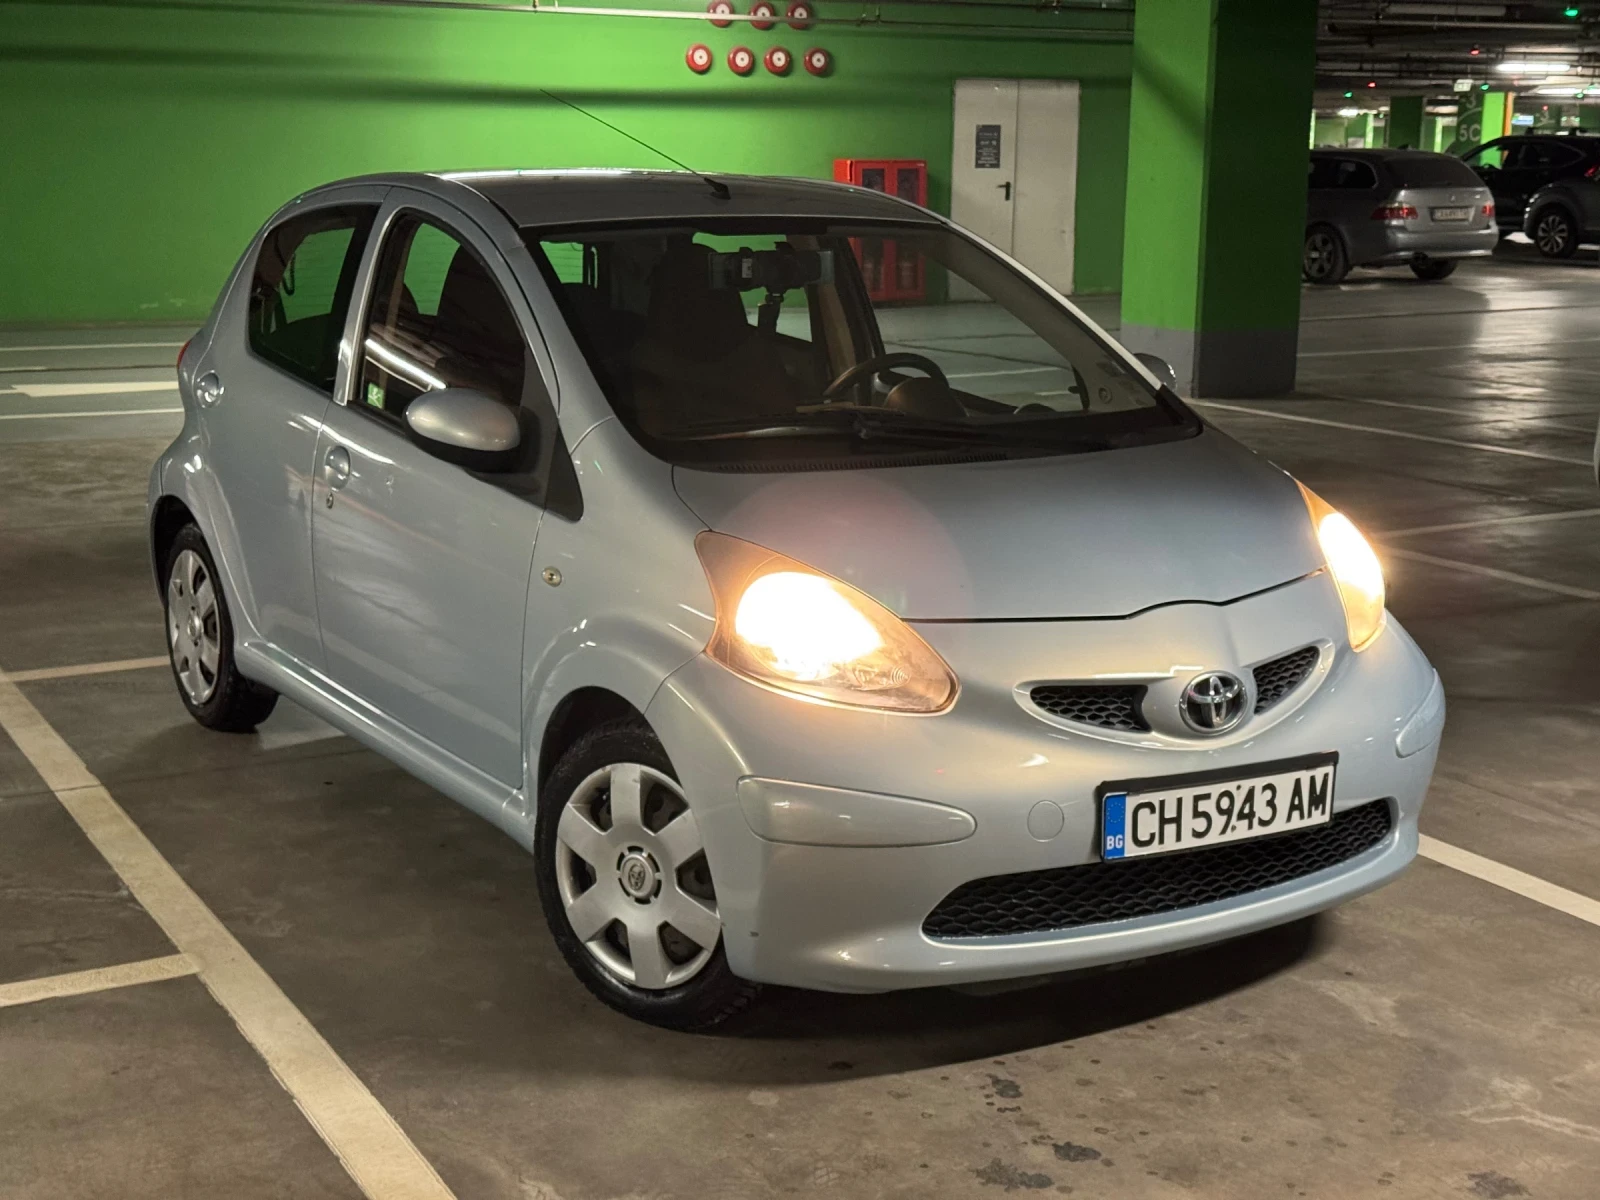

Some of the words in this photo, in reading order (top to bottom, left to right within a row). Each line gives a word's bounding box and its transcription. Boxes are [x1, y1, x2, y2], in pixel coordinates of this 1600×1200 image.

[1132, 797, 1183, 848] CH
[1192, 783, 1278, 839] 5943
[1286, 772, 1329, 823] AM
[1106, 834, 1123, 850] BG
